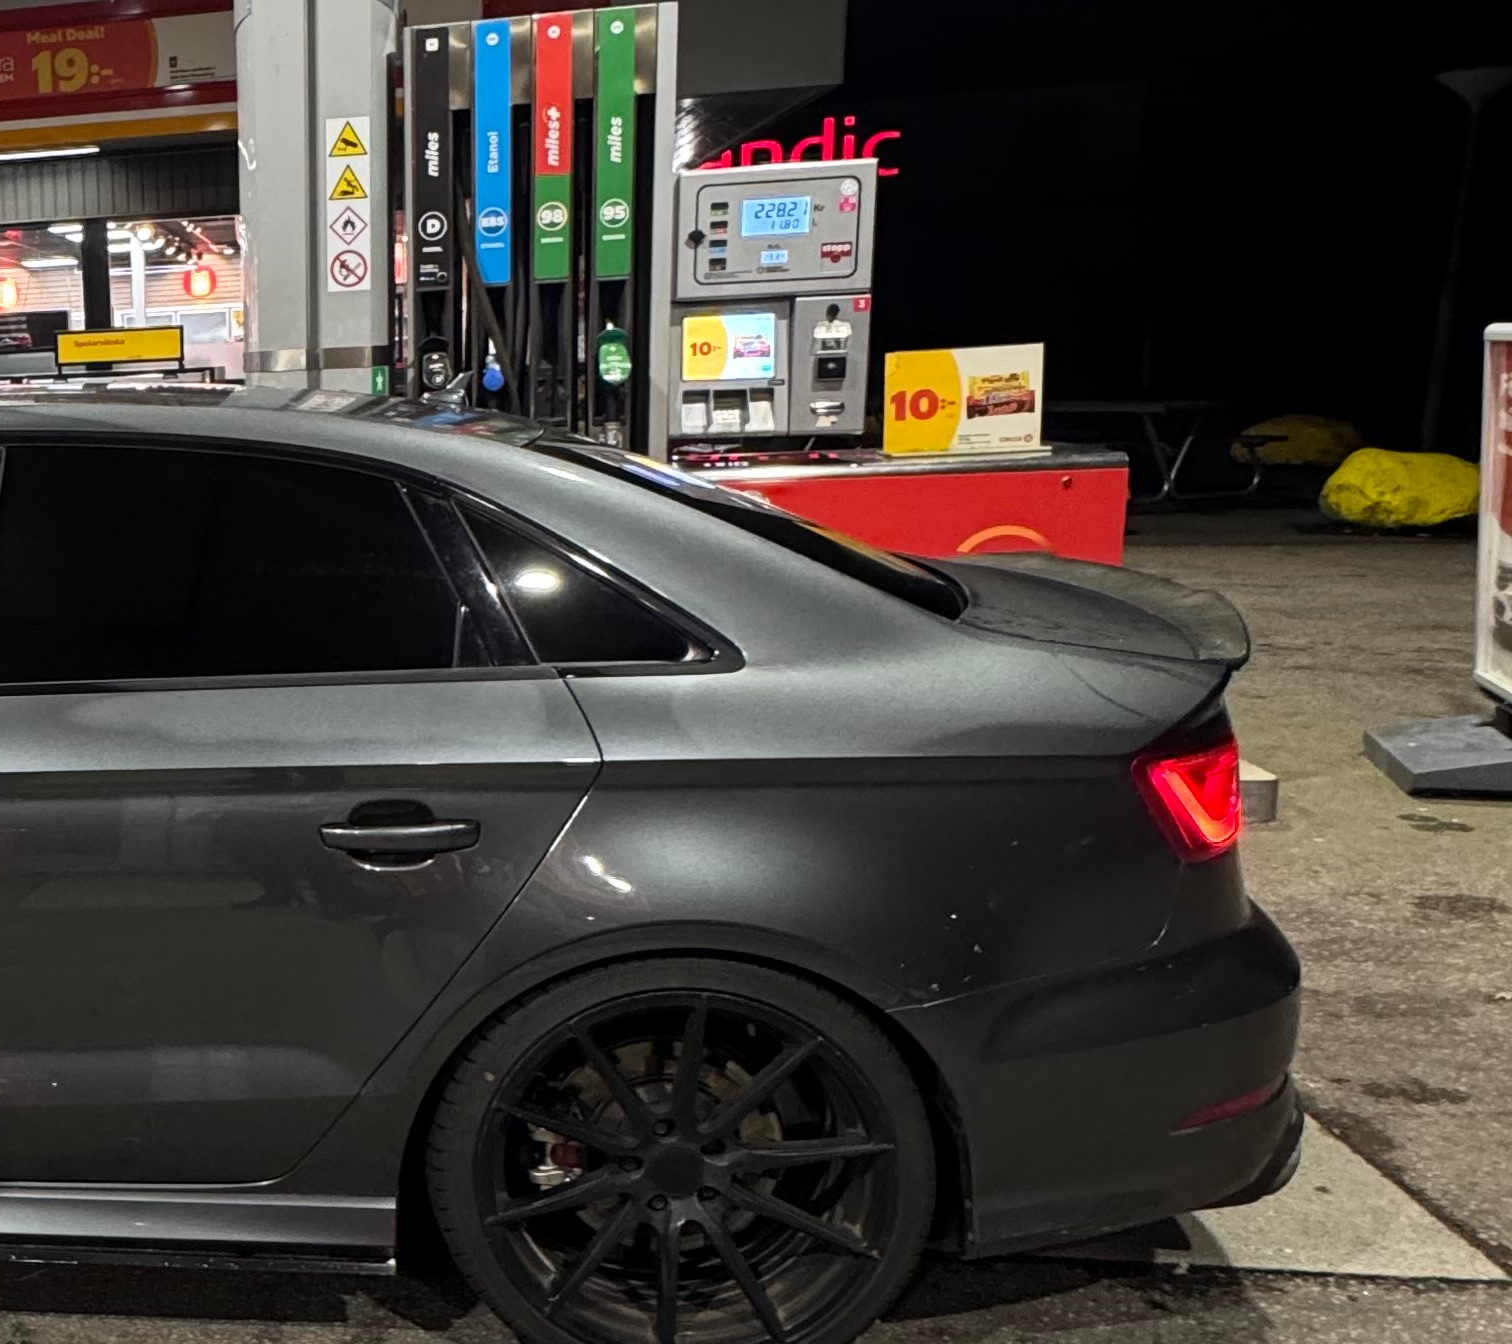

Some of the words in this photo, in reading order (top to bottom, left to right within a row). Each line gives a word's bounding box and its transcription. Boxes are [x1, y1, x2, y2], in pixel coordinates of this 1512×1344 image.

[26, 30, 64, 45] Meal
[66, 25, 105, 41] Deal!
[31, 47, 114, 94] 19:-
[487, 131, 500, 173] Etanol
[545, 105, 561, 167] miles+
[607, 116, 623, 164] miles
[425, 131, 440, 177] miles
[426, 219, 441, 234] D
[540, 209, 564, 224] 98
[603, 205, 627, 220] 95
[821, 243, 852, 253] stopp
[889, 388, 956, 422] 10:-
